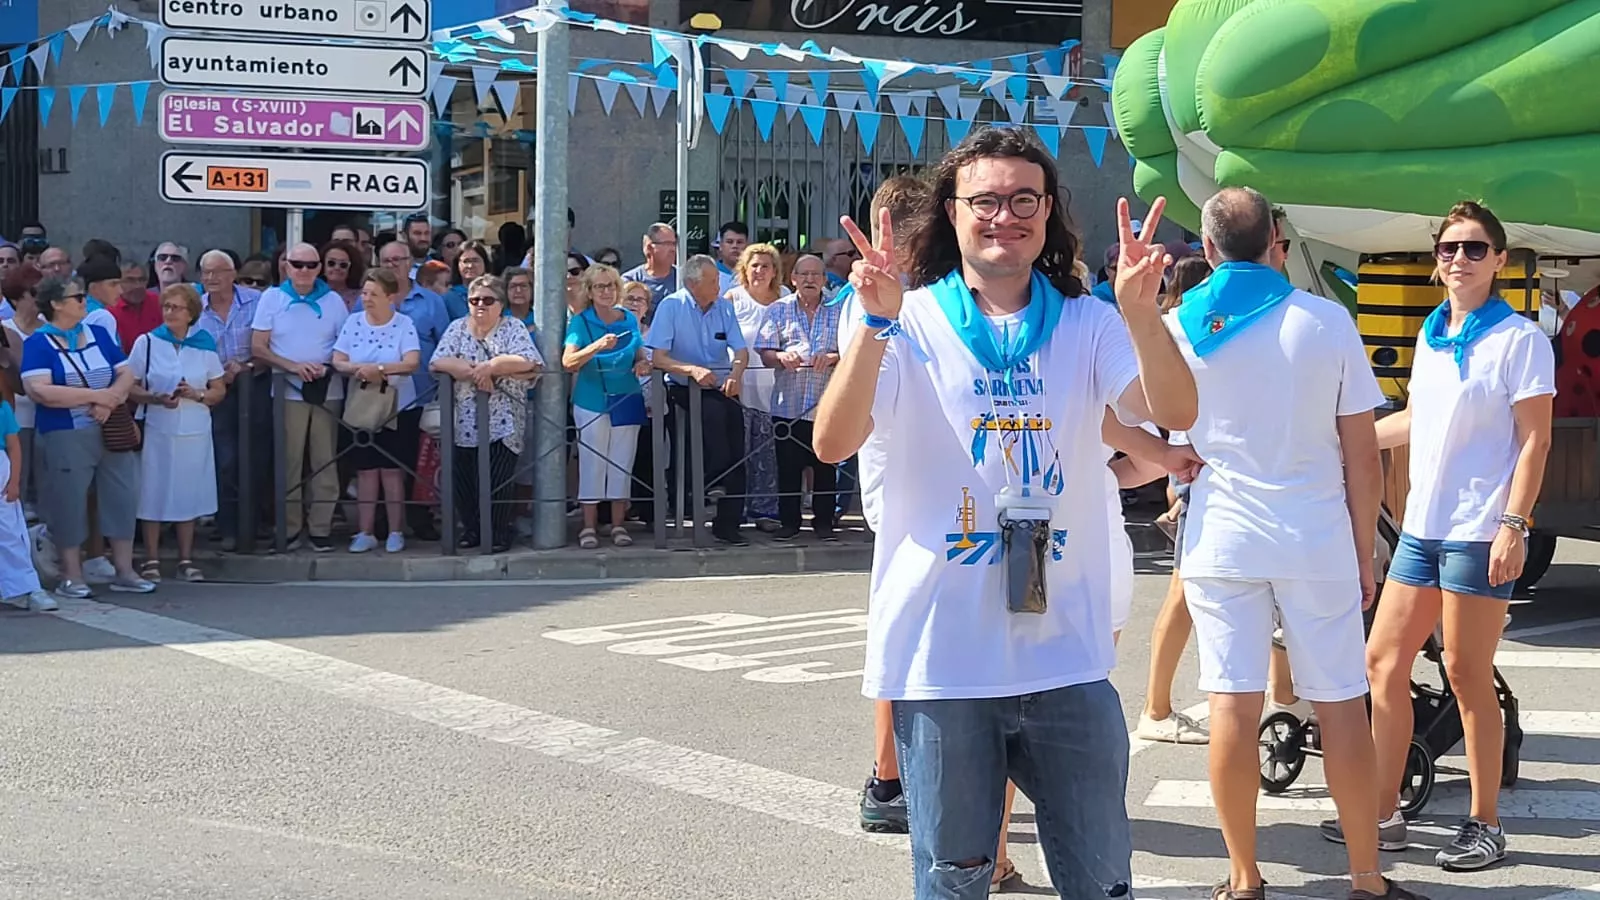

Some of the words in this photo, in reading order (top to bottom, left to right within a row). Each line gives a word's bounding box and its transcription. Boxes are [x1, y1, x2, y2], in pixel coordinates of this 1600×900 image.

[169, 0, 243, 16] centro
[260, 4, 338, 22] urbano
[168, 55, 329, 76] ayuntamiento
[168, 114, 193, 132] El
[214, 115, 325, 137] Salvador
[211, 170, 265, 188] A-131
[330, 172, 420, 194] FRAGA
